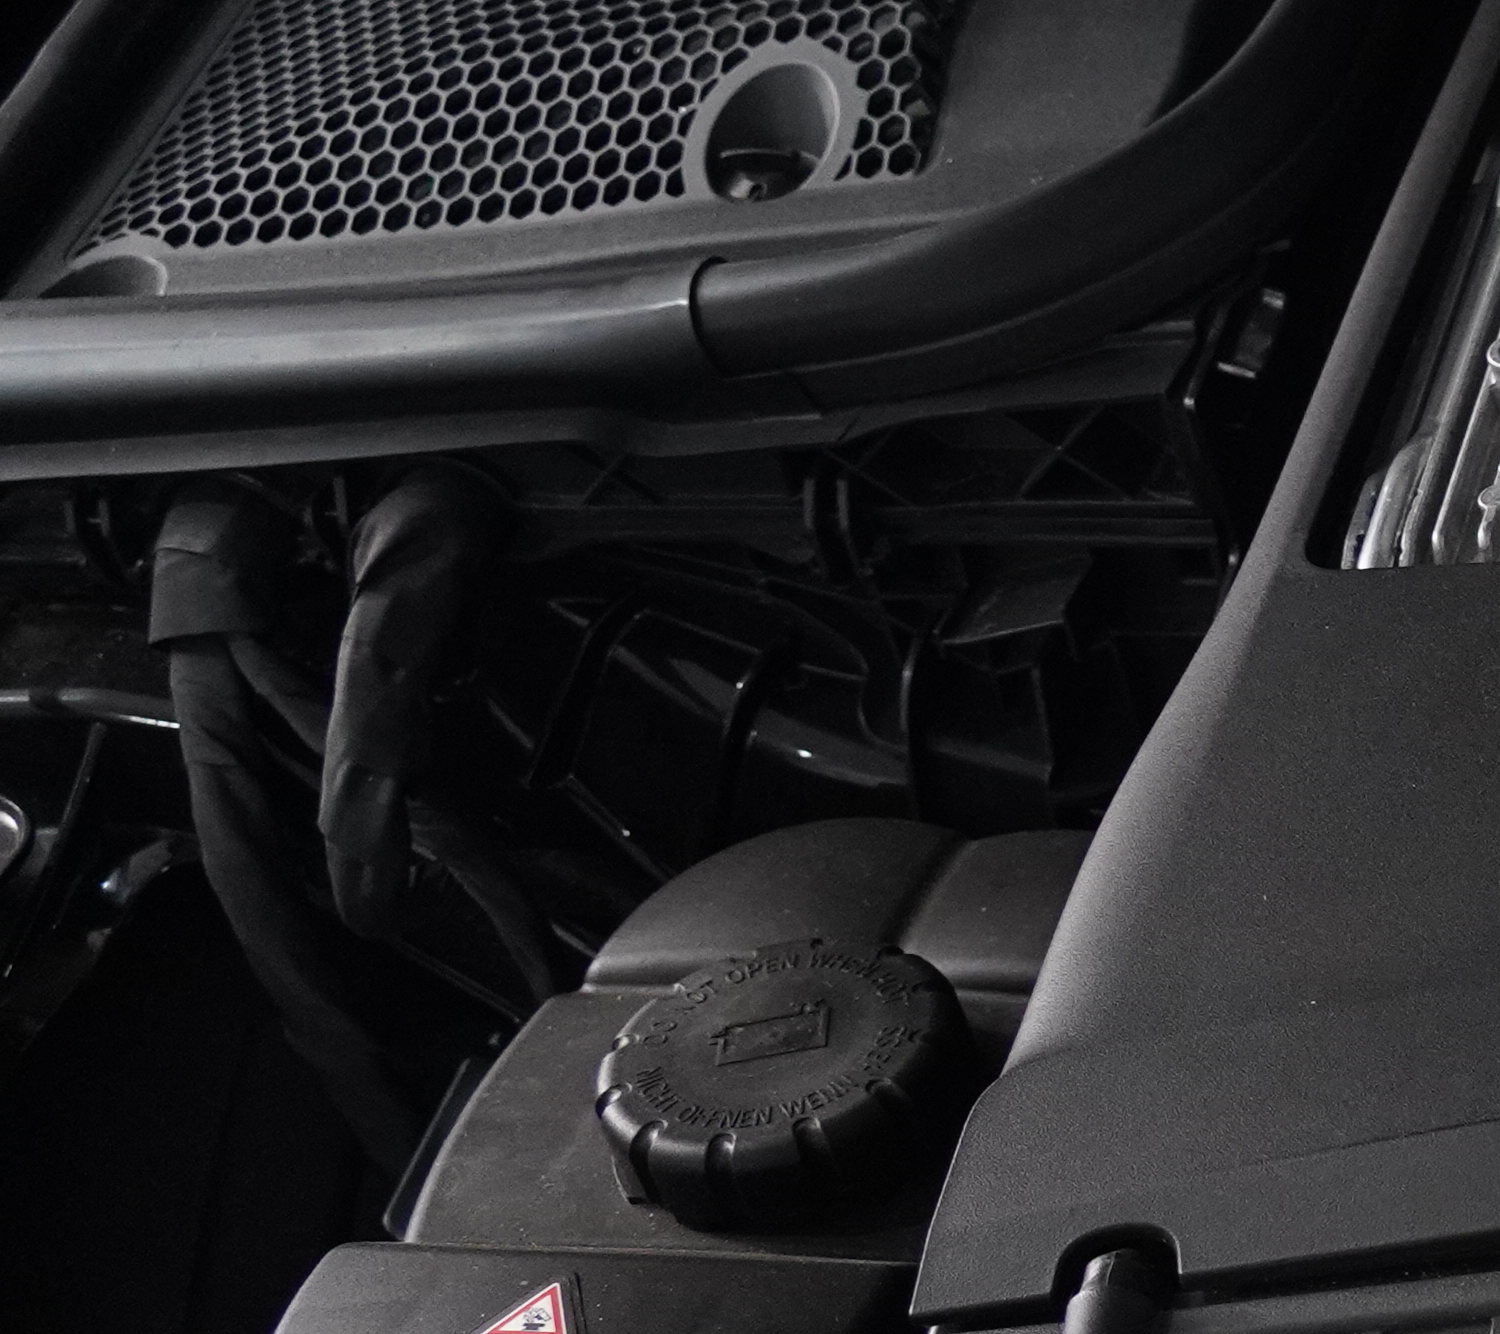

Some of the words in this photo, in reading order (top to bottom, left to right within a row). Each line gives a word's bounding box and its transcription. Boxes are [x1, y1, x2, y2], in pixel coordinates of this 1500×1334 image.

[724, 954, 801, 985] OPEN
[635, 1067, 684, 1114] NICHT
[778, 1075, 852, 1118] WENN
